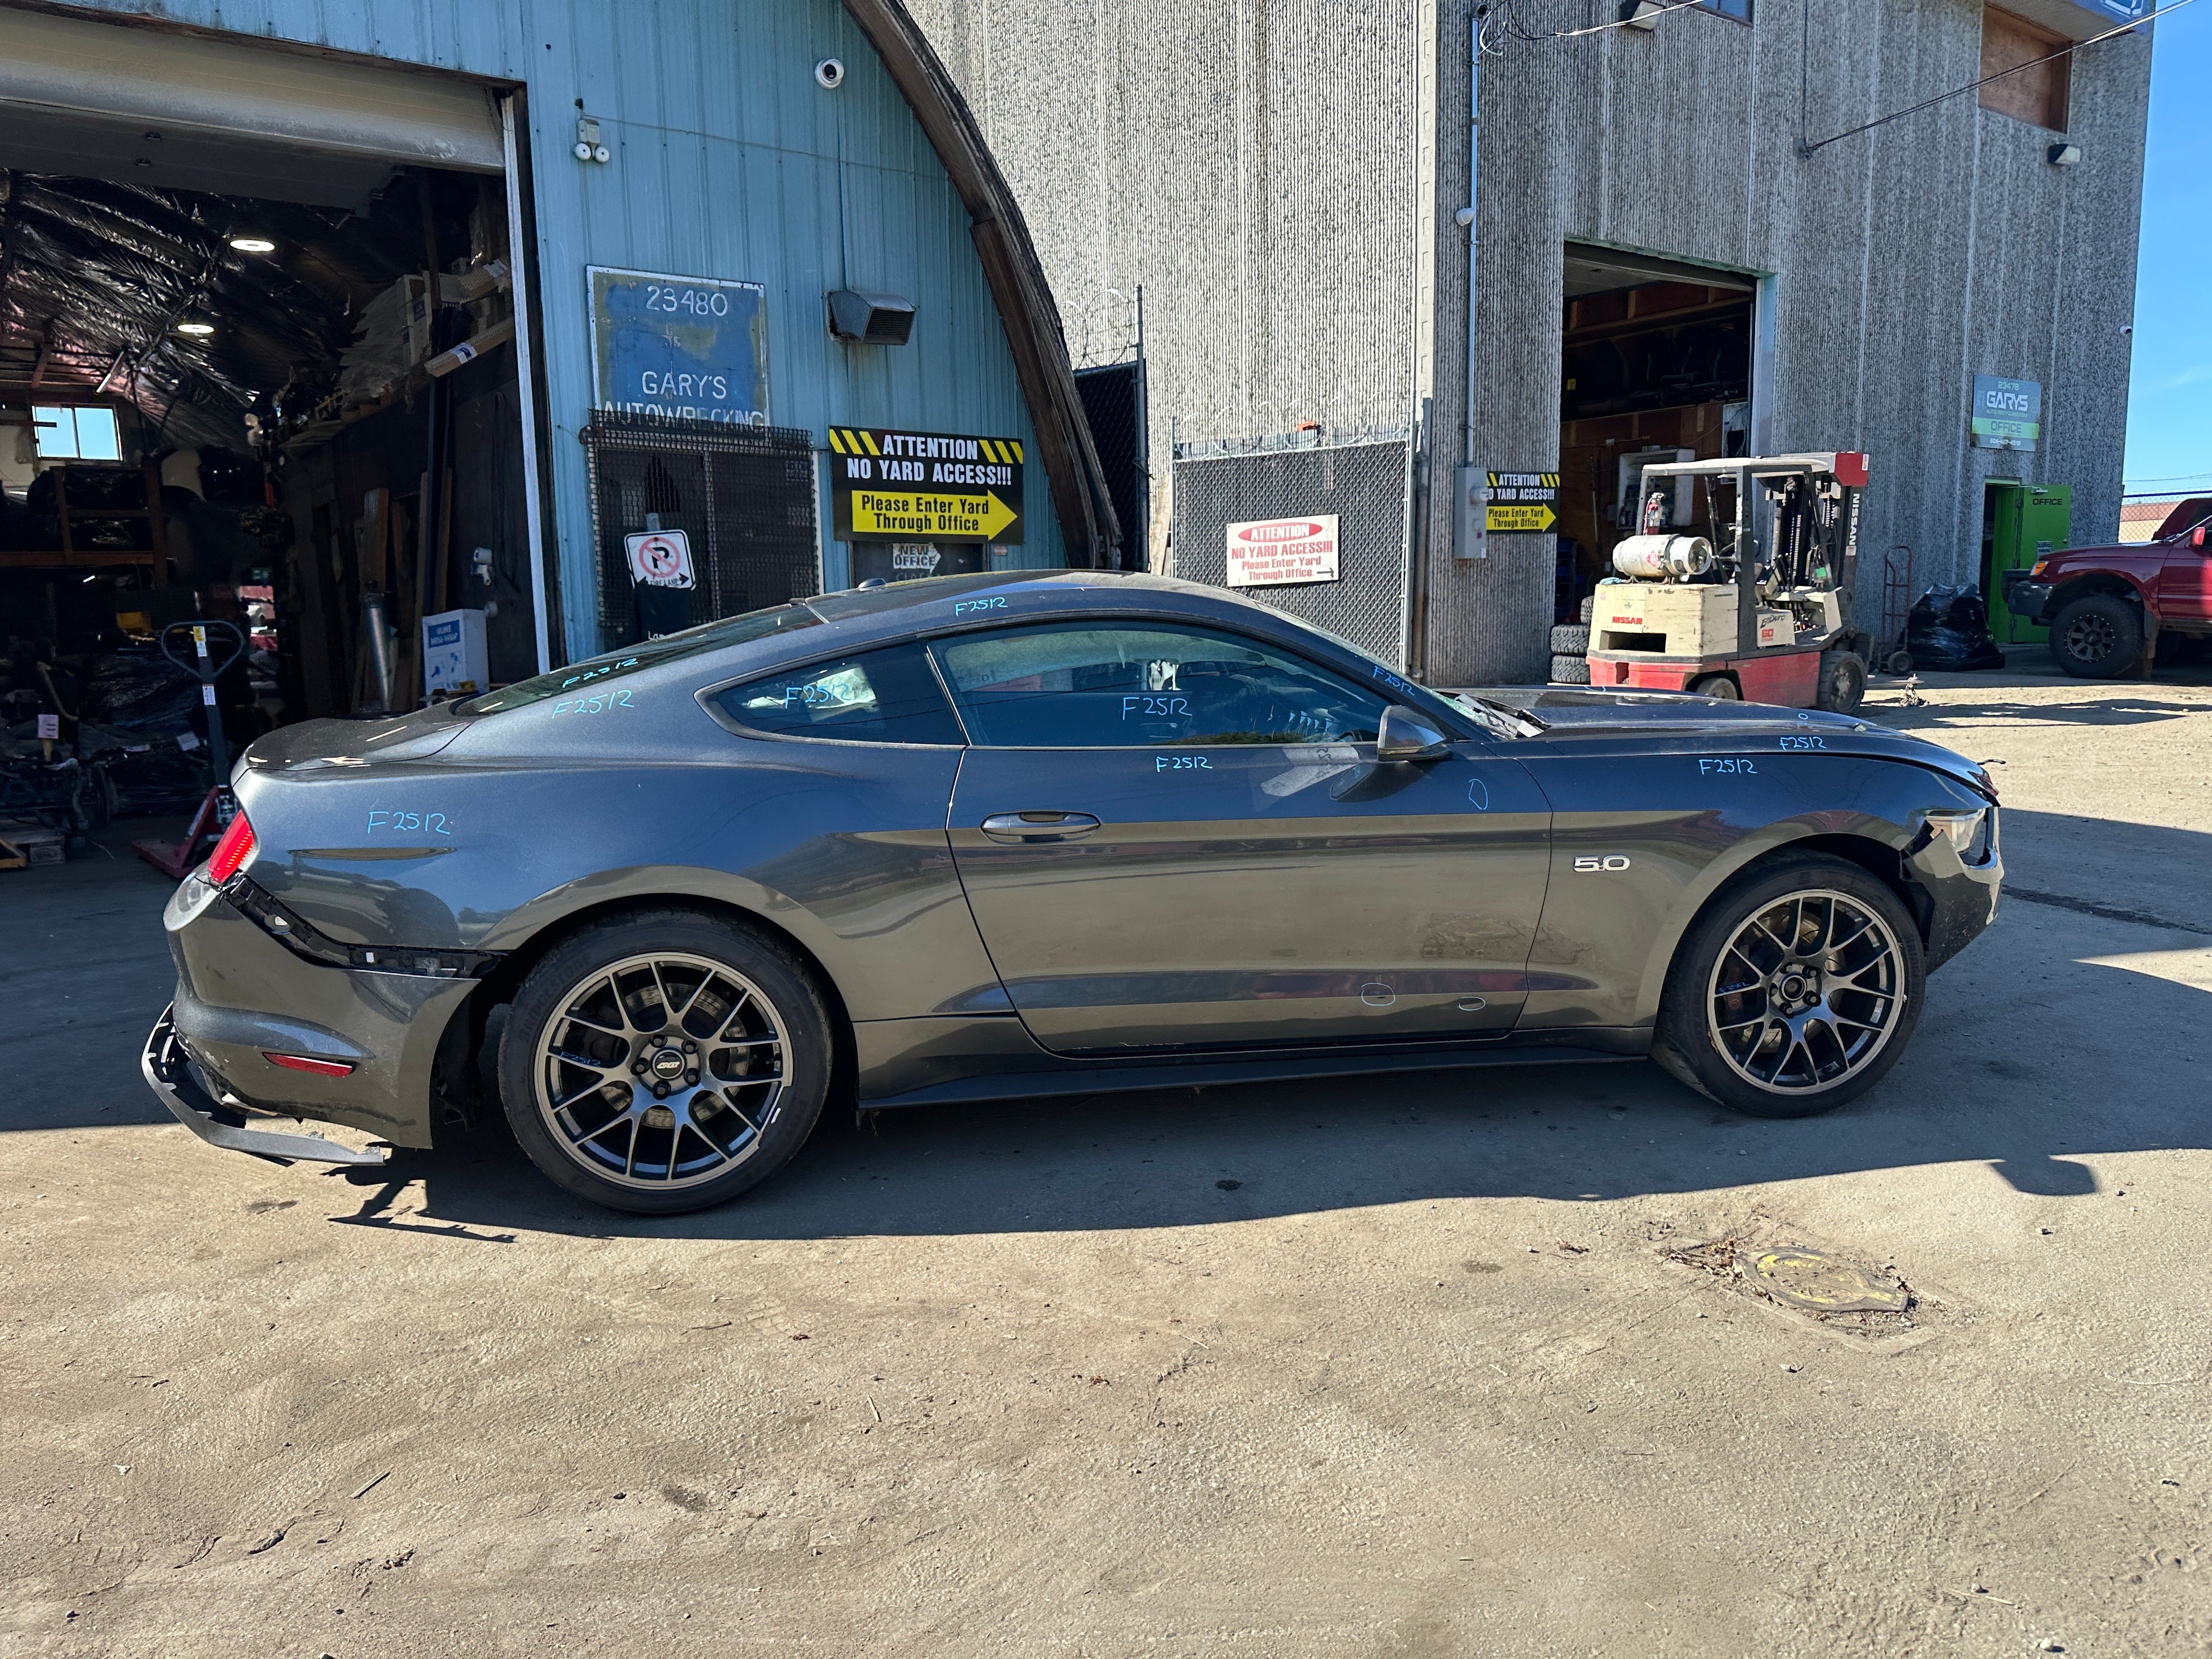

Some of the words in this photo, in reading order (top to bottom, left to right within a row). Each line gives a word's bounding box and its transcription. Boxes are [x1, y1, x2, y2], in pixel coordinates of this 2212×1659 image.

[646, 285, 728, 316] 23480
[641, 371, 727, 399] GARY'S
[1986, 391, 2028, 411] GARYS
[1991, 421, 2022, 433] OFFICE
[882, 435, 978, 460] ATTENTION
[847, 458, 871, 479] NO
[879, 460, 925, 482] YARD
[932, 463, 1012, 485] ACCESS!!!
[1498, 474, 1540, 486] ATTENTION
[1488, 488, 1494, 500] O
[1497, 488, 1516, 500] YARD
[1519, 488, 1555, 500] ACCESS!!!
[862, 495, 909, 512] Please
[916, 497, 953, 513] Enter
[959, 498, 989, 514] Yard
[1488, 509, 1509, 517] Please
[1512, 509, 1528, 517] Enter
[1531, 509, 1544, 517] Yard
[874, 513, 931, 532] Through
[938, 515, 979, 531] Office
[1494, 518, 1518, 528] Through
[1521, 518, 1539, 527] Office
[1849, 493, 1860, 546] NISSAN
[1251, 524, 1309, 541] ATTENTION
[900, 545, 929, 556] NEW
[1232, 547, 1245, 559] NO
[1249, 545, 1278, 558] YARD
[1281, 541, 1333, 556] ACCESS!!!
[895, 555, 936, 566] OFFICE
[1242, 560, 1269, 570] Please
[1272, 558, 1296, 568] Enter
[1299, 556, 1321, 566] Yard
[1249, 570, 1283, 581] Through
[955, 597, 1007, 616] F2512
[1612, 616, 1643, 624] NISSAN
[1762, 628, 1774, 638] 60
[1373, 665, 1415, 696] F2512
[552, 690, 634, 719] F2512
[785, 684, 851, 709] F2512
[1123, 697, 1192, 720] F2512
[1780, 737, 1827, 750] F2512
[1156, 756, 1213, 772] F2512
[1699, 759, 1758, 775] F2512
[367, 810, 450, 834] F2512
[1573, 854, 1630, 872] 5.0
[560, 1051, 601, 1067] F2512
